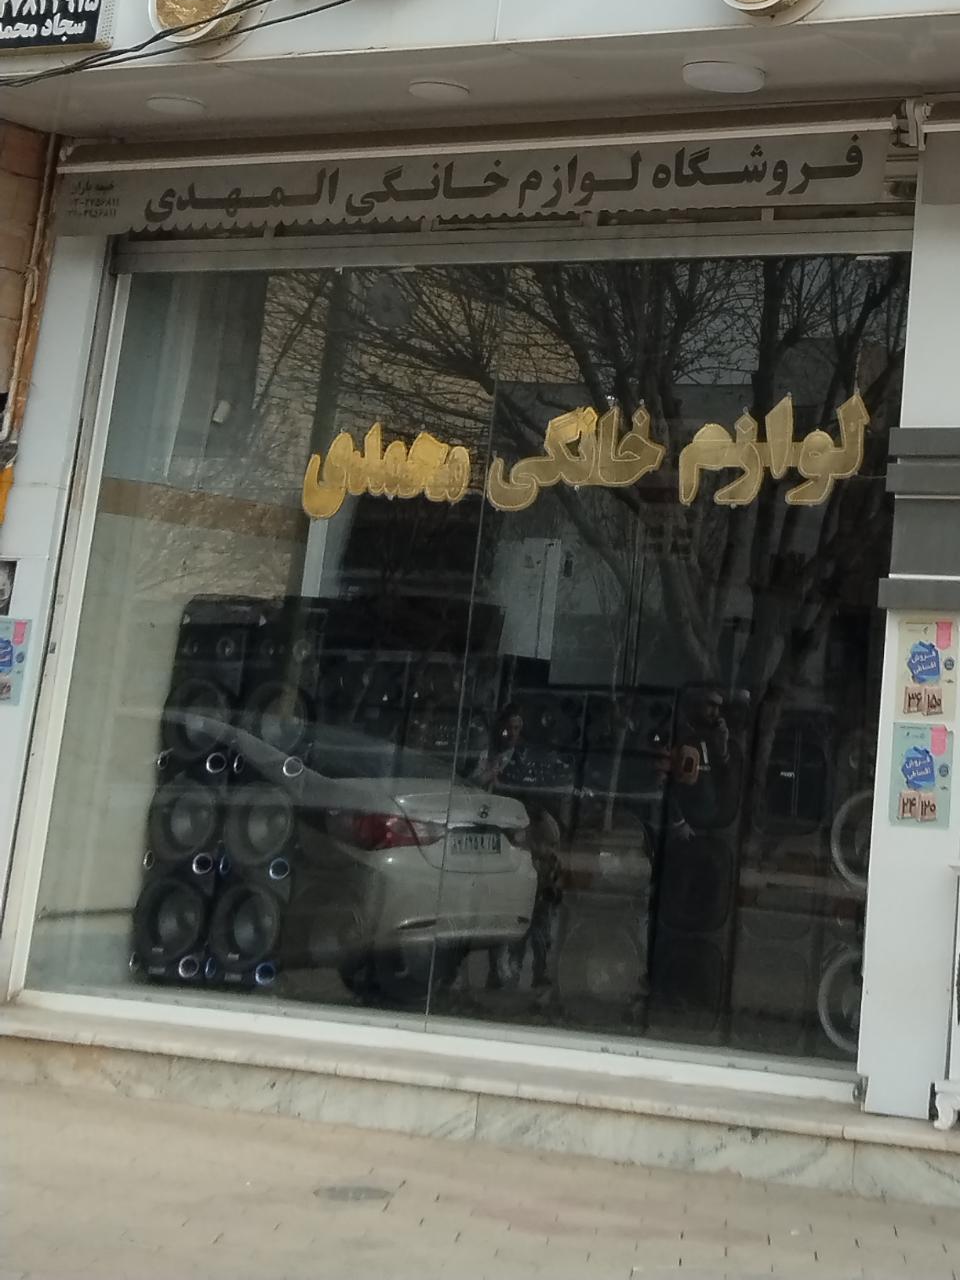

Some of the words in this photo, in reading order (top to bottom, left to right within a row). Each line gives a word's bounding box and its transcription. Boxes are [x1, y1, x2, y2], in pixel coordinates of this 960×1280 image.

[0, 20, 38, 39] محم
[41, 13, 86, 42] سجاد
[344, 158, 509, 216] خانگی
[518, 150, 642, 208] لوازم
[651, 134, 864, 196] فروشگاه
[144, 167, 340, 222] المهدی
[486, 405, 667, 511] خانگی
[677, 393, 870, 506] لوازم
